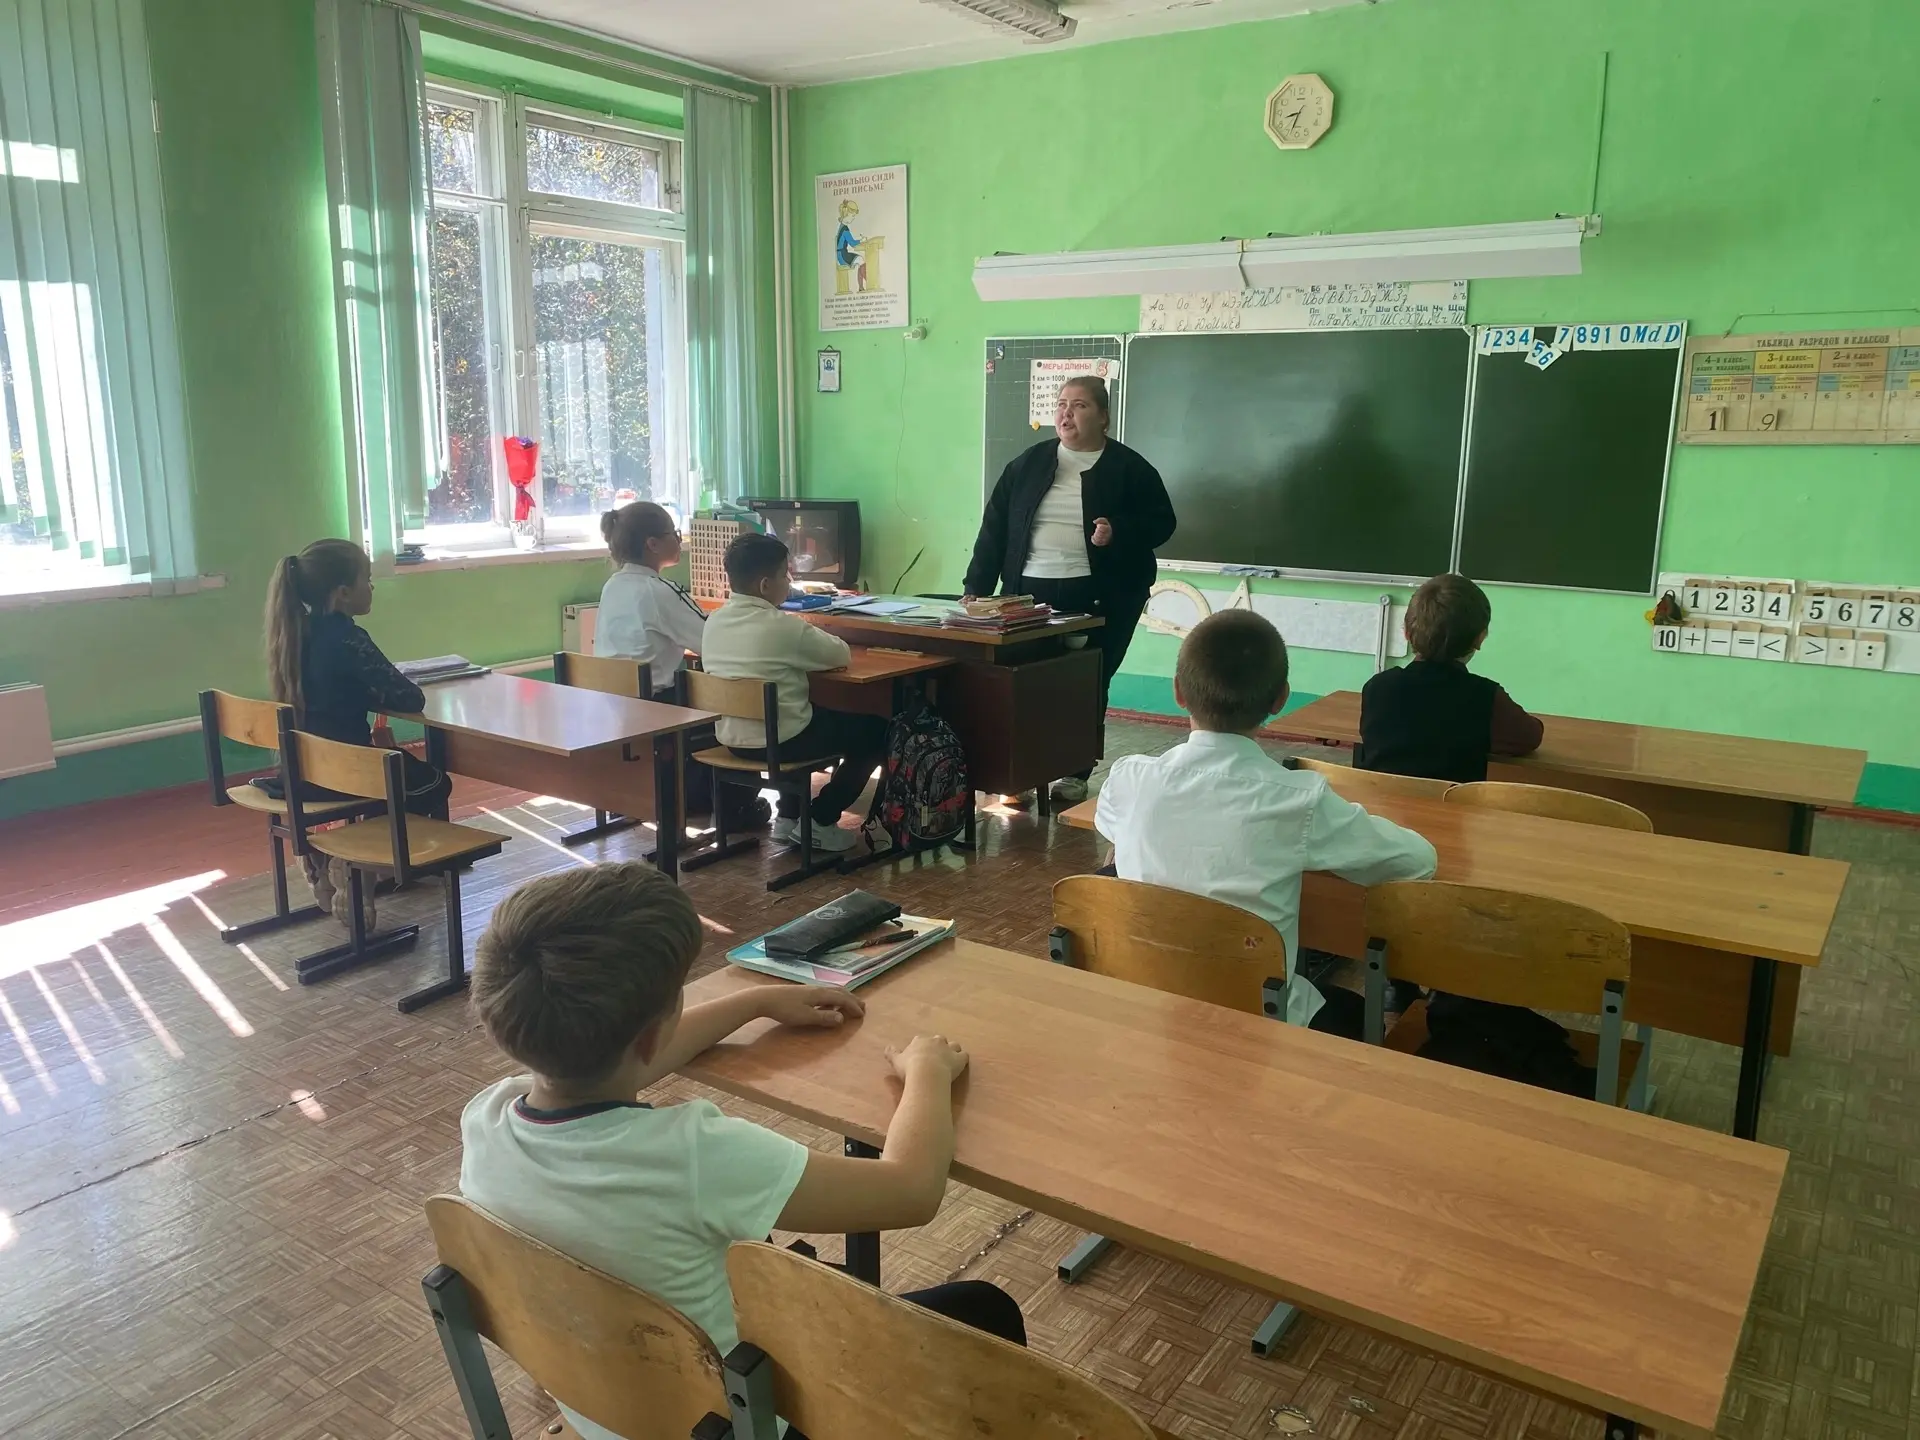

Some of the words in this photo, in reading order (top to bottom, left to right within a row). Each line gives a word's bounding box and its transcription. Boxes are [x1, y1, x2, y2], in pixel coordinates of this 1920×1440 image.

[1304, 128, 1310, 136] 5
[822, 176, 870, 188] ПРАВИЛЬНО
[871, 172, 894, 182] СИДИ
[833, 188, 849, 196] ПРИ
[851, 183, 885, 194] ПИСЬМЕ
[1448, 304, 1465, 312] Щщ
[1483, 332, 1491, 349] 1
[1493, 330, 1503, 347] 2
[1506, 332, 1516, 346] 3
[1519, 329, 1530, 346] 4
[1558, 327, 1570, 344] 7
[1576, 326, 1587, 344] 8
[1590, 327, 1601, 343] 9
[1647, 325, 1660, 343] d
[1664, 324, 1681, 343] D
[1757, 338, 1794, 348] ТАБЛИЦА
[1798, 336, 1840, 347] РАЗРЯДОВ
[1843, 336, 1850, 345] И
[1851, 334, 1890, 345] КЛАССОВ
[1532, 341, 1545, 358] 5
[1538, 352, 1554, 366] 6
[1064, 363, 1092, 371] ДЛИНЫ
[1695, 394, 1704, 402] 12
[1846, 391, 1852, 399] 5
[1868, 391, 1874, 399] 4
[1709, 410, 1717, 431] 1
[1690, 590, 1700, 609] 1
[1715, 592, 1729, 611] 2
[1741, 594, 1755, 613] 3
[1768, 596, 1781, 616] 4
[1809, 600, 1825, 620] 5
[1838, 602, 1853, 621] 6
[1869, 604, 1884, 624] 7
[1897, 607, 1915, 627] 8
[1658, 629, 1676, 648] 10
